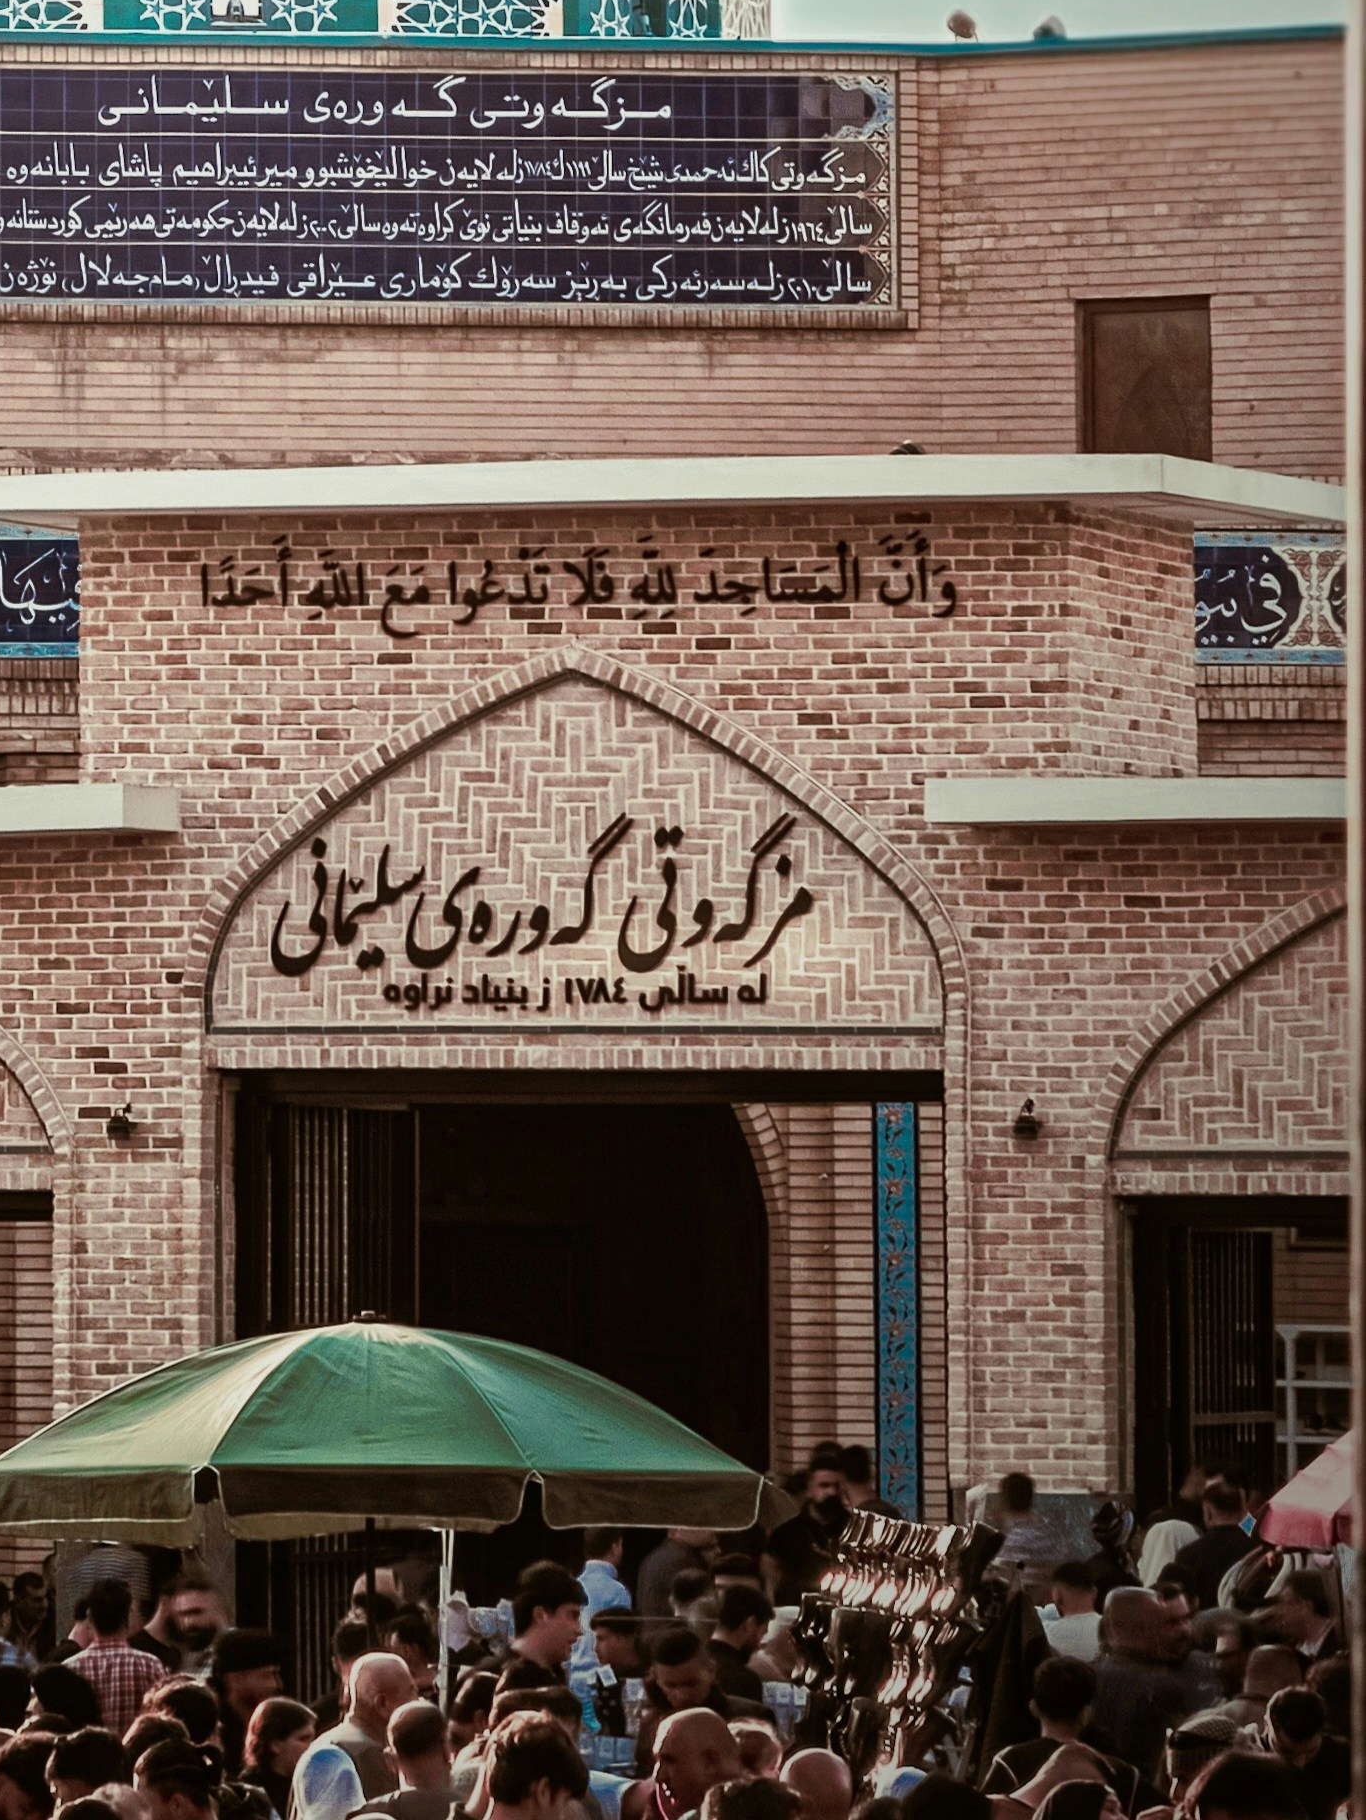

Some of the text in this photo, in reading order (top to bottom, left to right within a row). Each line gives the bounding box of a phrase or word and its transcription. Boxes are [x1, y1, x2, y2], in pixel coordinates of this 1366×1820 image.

[98, 74, 672, 130] مزگەوتی گەورەی سلێمانی
[98, 142, 163, 188] پاشای
[772, 147, 866, 191] مزگەوتی
[271, 811, 814, 977] مزگەوتی گەورەی سلێمانی
[461, 973, 529, 1012] بنیاد
[564, 976, 629, 1005] ١٧٨٤
[736, 972, 768, 1005] لە
